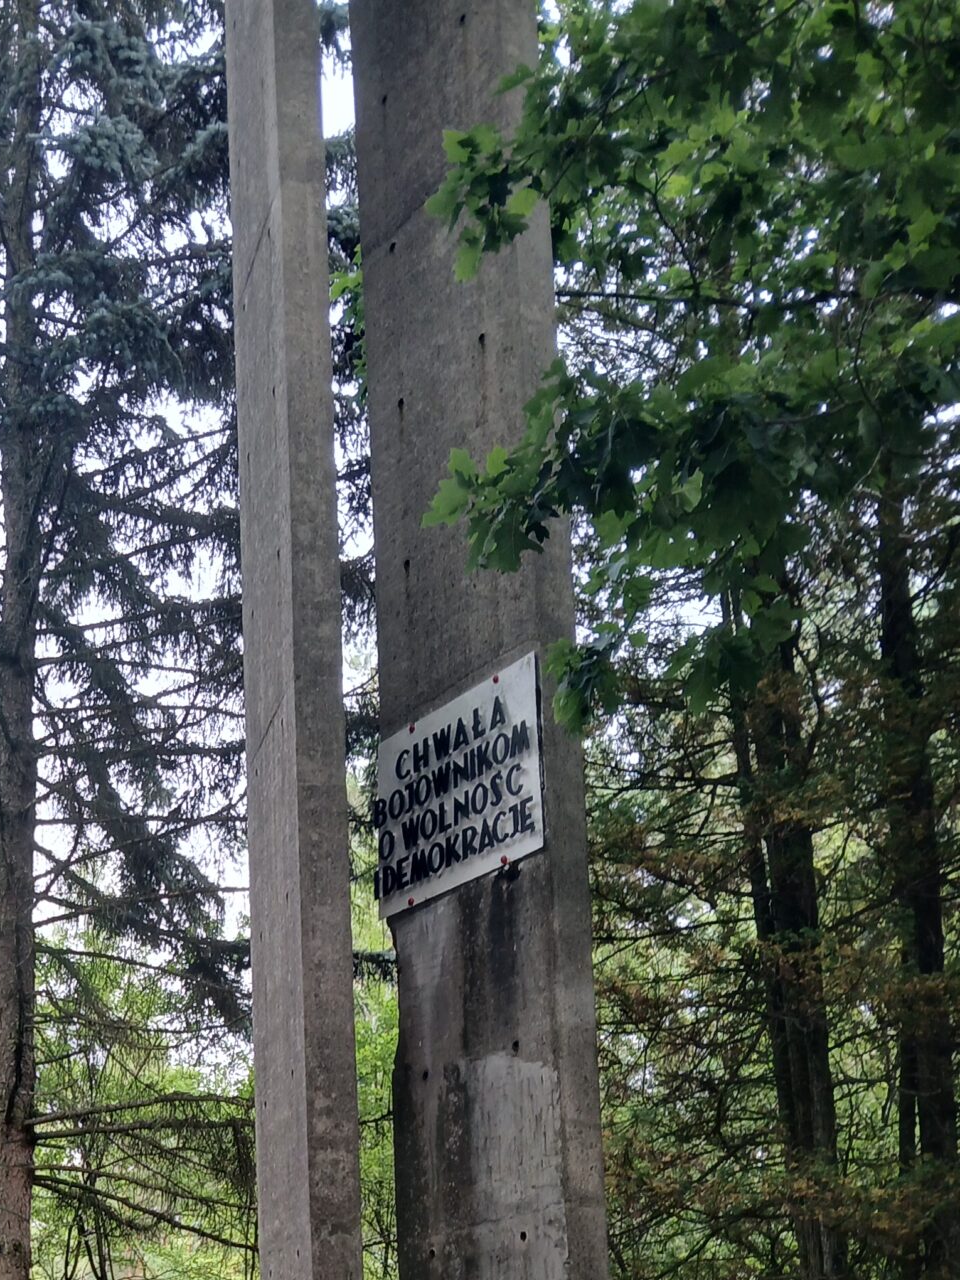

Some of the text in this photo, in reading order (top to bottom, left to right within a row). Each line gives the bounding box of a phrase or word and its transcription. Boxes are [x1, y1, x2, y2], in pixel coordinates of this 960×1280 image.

[374, 720, 530, 829] BOJOWNIKOM
[395, 696, 506, 780] CHWAŁA
[379, 829, 395, 861] O
